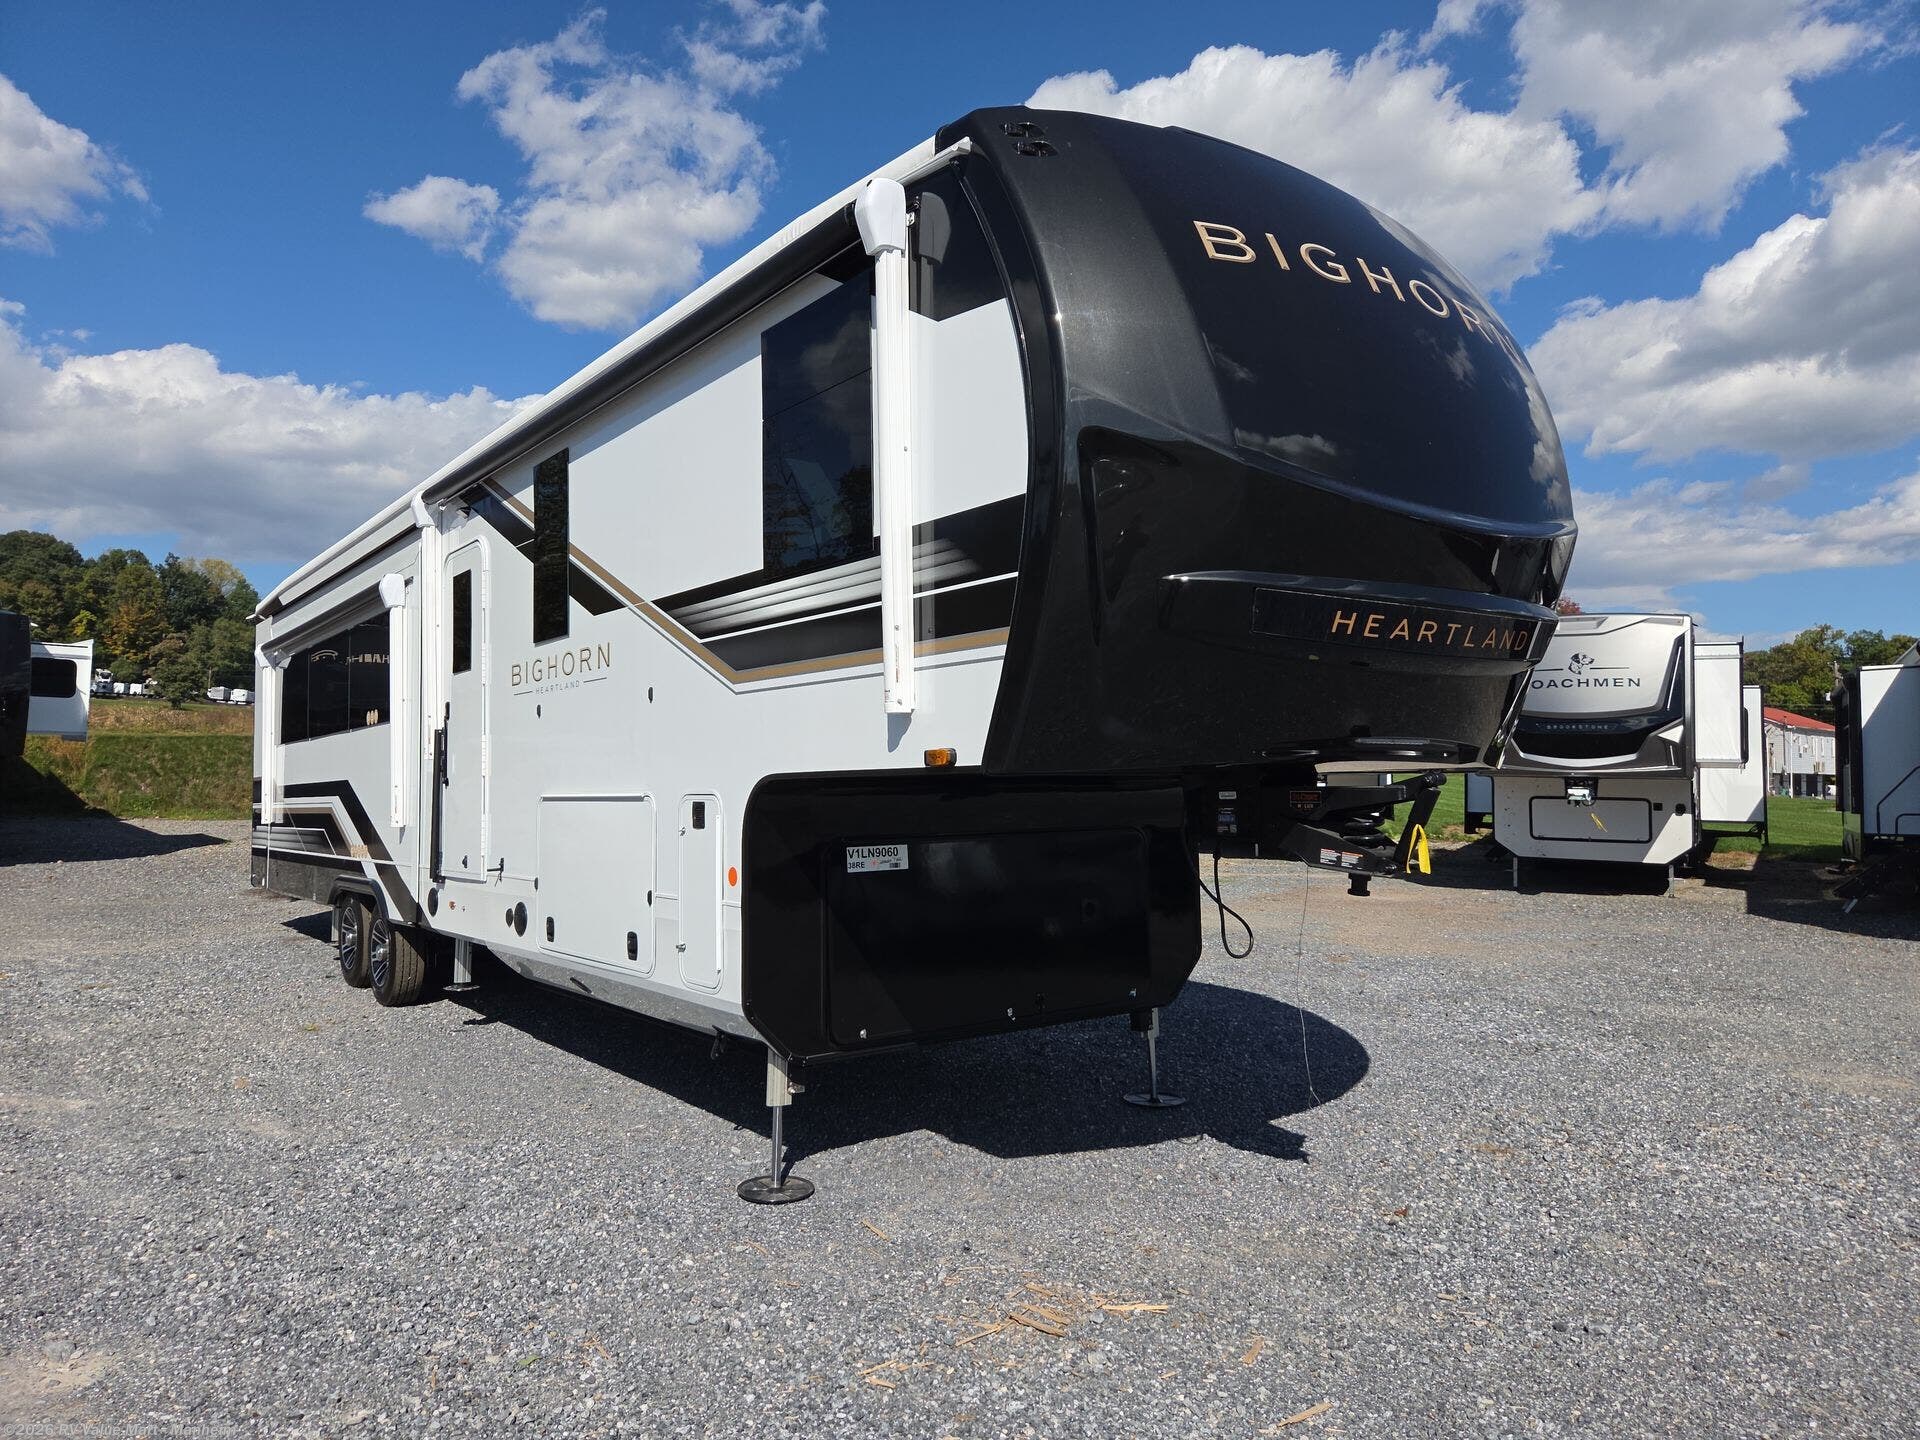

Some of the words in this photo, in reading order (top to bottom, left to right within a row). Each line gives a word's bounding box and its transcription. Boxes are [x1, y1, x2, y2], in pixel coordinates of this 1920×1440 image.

[1193, 220, 1523, 366] BIGHORN
[1331, 610, 1528, 651] HEARTLAND
[511, 642, 610, 686] BIGHORN
[535, 680, 580, 695] HEARTLAND
[1531, 677, 1641, 690] OACHMEN
[848, 847, 898, 859] V1LN9060
